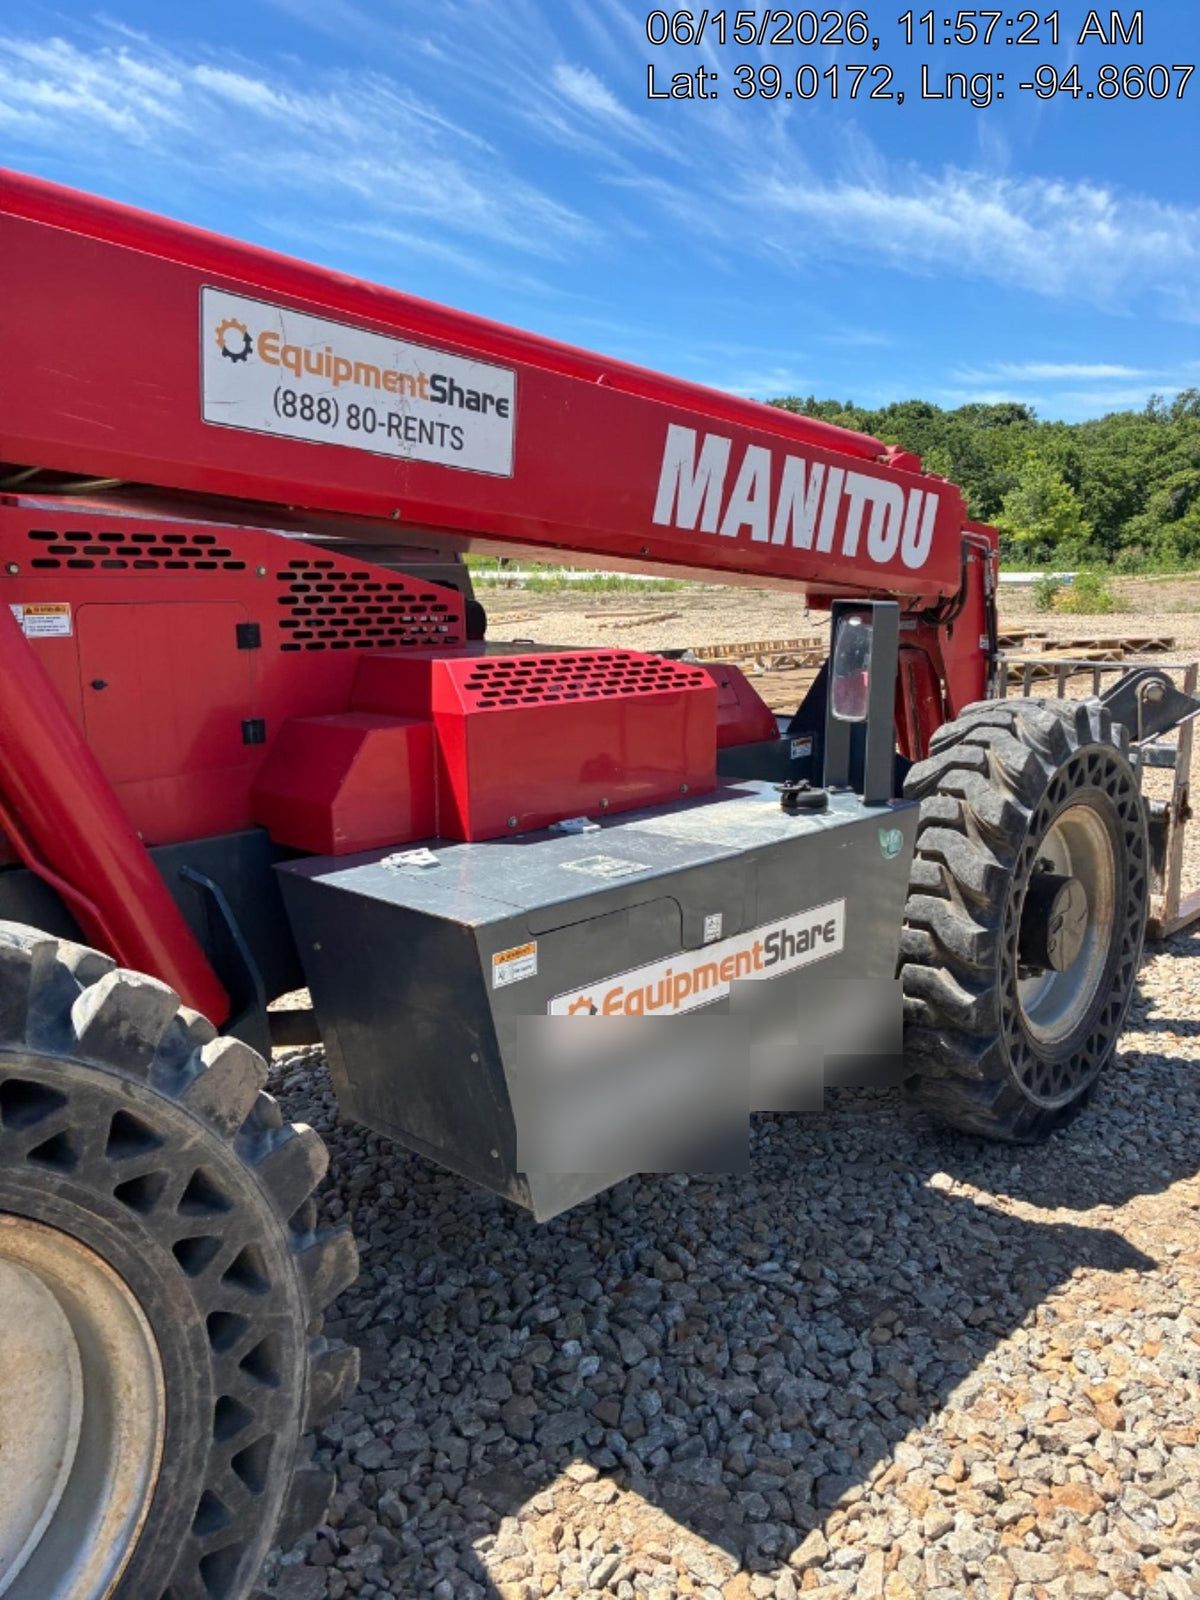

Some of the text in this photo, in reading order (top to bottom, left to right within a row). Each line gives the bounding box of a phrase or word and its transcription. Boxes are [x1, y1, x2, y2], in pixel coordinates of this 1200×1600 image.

[257, 331, 509, 418] EquipmentShare
[273, 386, 464, 451] (888) 80-RENTS
[652, 423, 939, 569] MANITOU
[602, 919, 835, 1015] EquipmentShare
